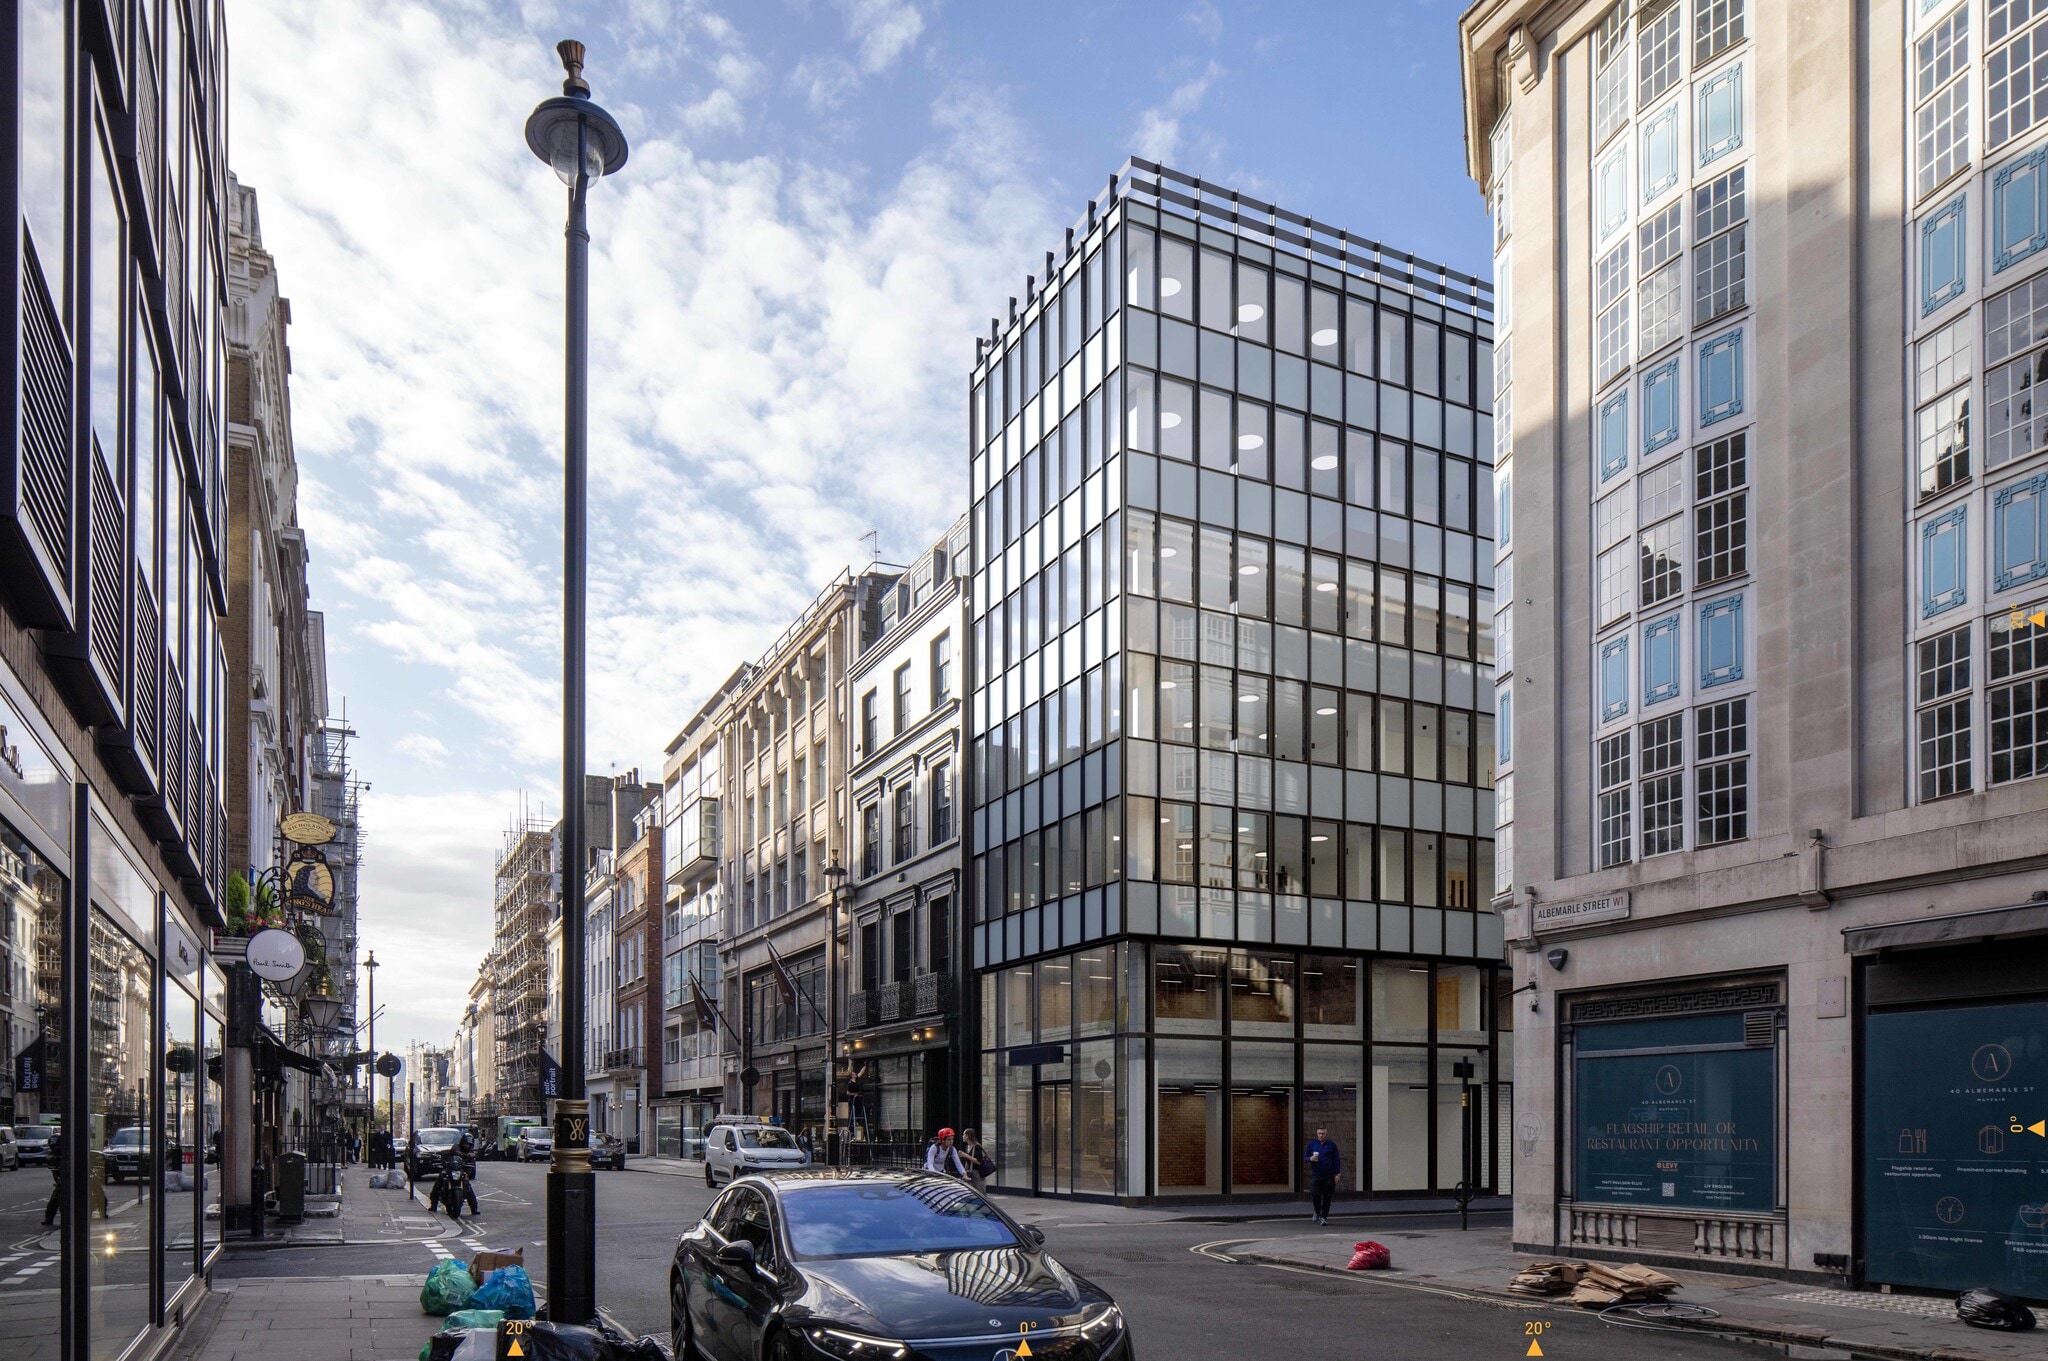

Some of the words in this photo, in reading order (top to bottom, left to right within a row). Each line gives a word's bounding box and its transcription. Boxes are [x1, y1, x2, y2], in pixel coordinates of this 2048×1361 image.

[311, 903, 332, 914] HEAD
[1537, 904, 1580, 919] ALBEMARLE
[1583, 898, 1610, 912] STREET
[1612, 896, 1624, 907] W1
[253, 957, 270, 967] Paul
[272, 960, 296, 969] Smith
[1984, 1052, 1998, 1073] A
[549, 1067, 558, 1096] portrait
[1663, 1071, 1674, 1088] A
[1606, 1122, 1664, 1135] FLAGSHIP
[1668, 1122, 1711, 1135] RETAIL
[1715, 1122, 1736, 1135] OR
[1587, 1138, 1661, 1150] RESTAURANT
[1665, 1138, 1759, 1151] OPPORTUNITY
